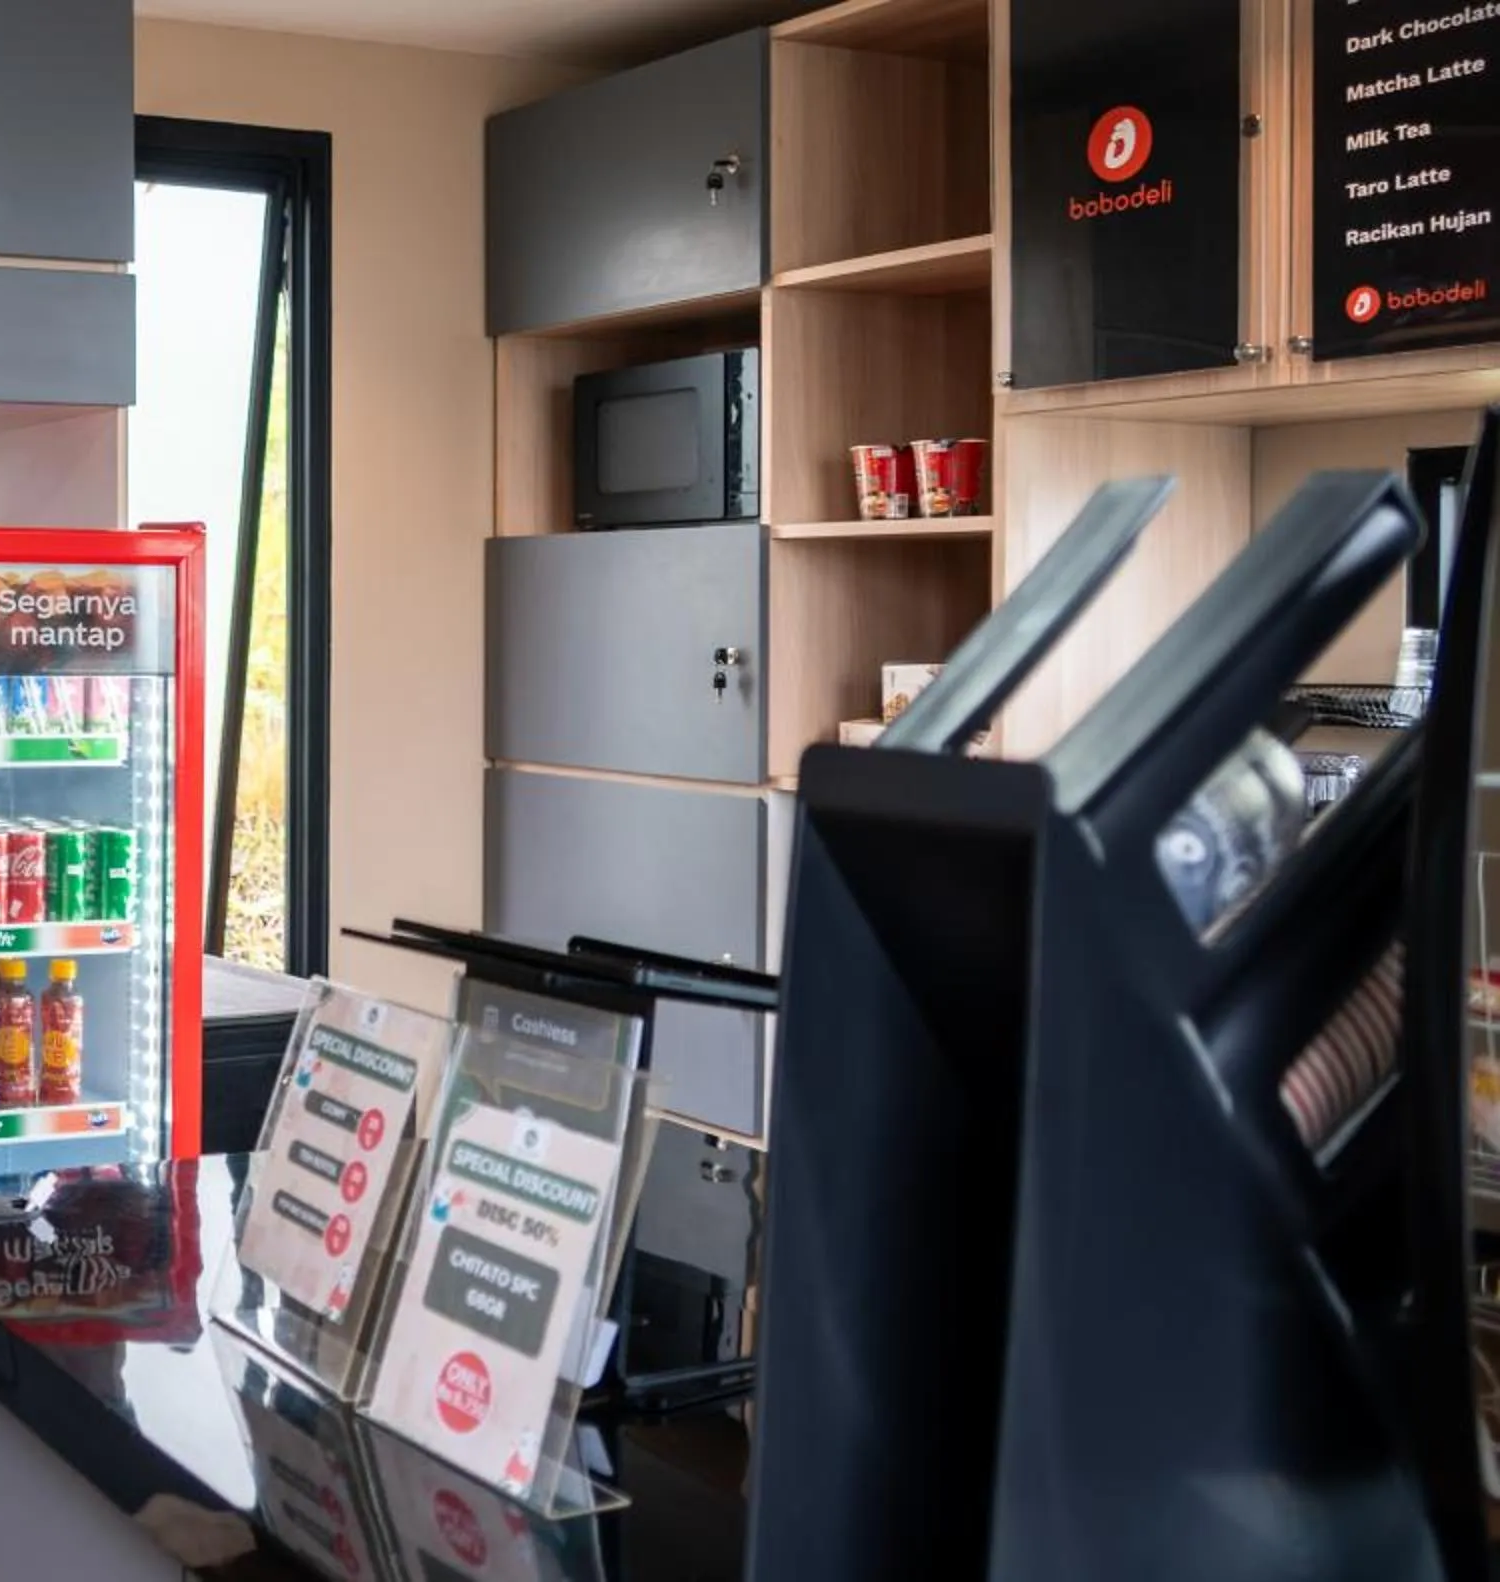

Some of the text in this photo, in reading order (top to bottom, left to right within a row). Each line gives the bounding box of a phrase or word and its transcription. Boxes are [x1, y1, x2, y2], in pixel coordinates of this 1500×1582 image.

[1346, 28, 1394, 54] Dark
[1346, 58, 1486, 102] Matcha Latte
[1346, 123, 1432, 152] Milk Tea
[1069, 179, 1172, 220] bobodeli
[1345, 168, 1452, 199] Taro Latte
[1346, 210, 1491, 246] Racikan Hujan
[1387, 280, 1486, 310] bobodeli
[10, 621, 124, 649] mantap
[453, 1147, 597, 1215] SPECIAL DISCOUNT
[476, 1199, 520, 1231] DISC
[450, 1248, 511, 1288] CHITATO
